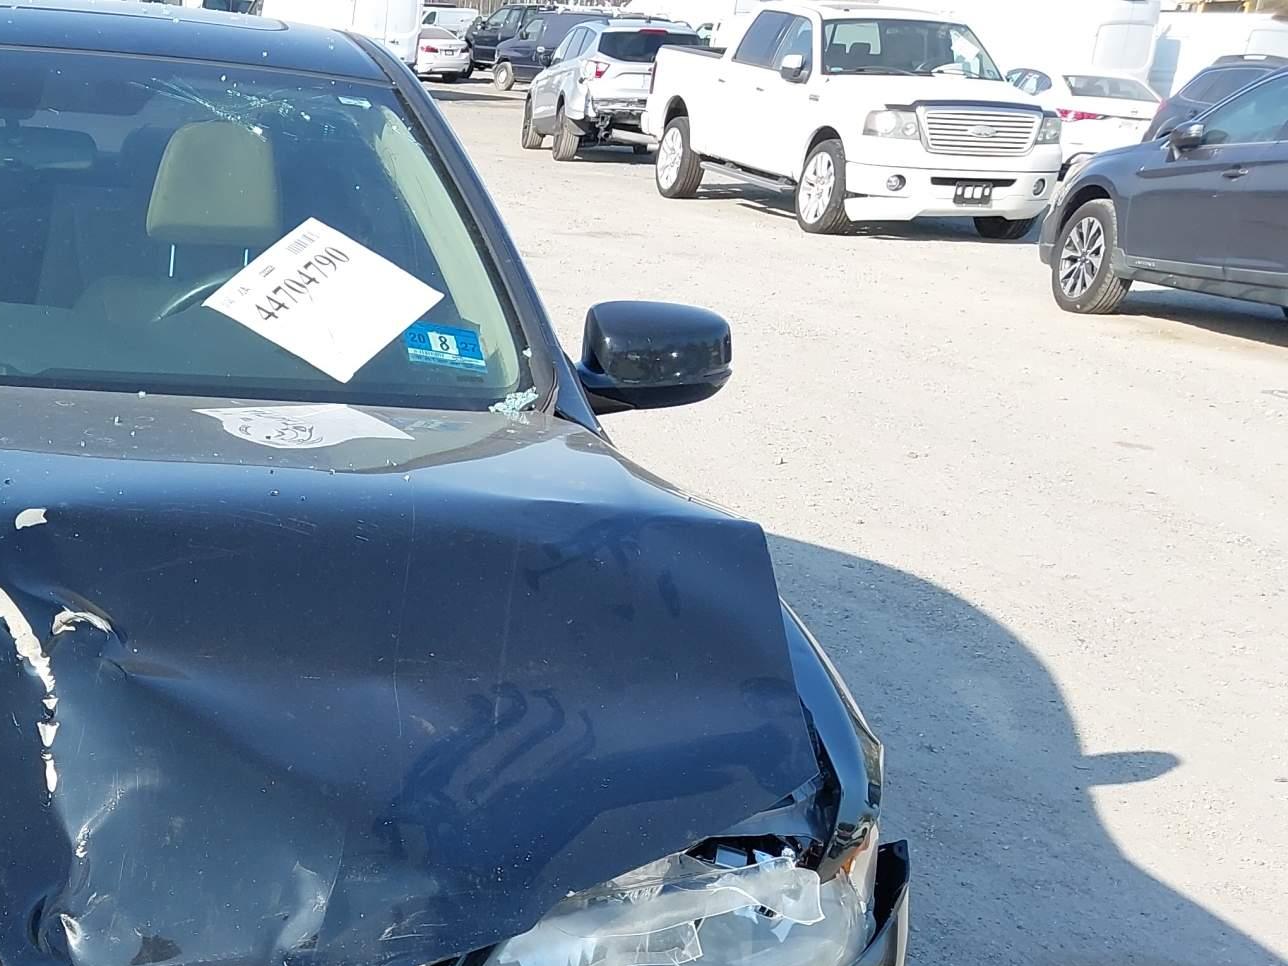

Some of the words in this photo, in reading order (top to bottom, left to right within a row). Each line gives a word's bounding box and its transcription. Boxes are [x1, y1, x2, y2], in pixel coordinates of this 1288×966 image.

[255, 246, 350, 320] 44704790
[408, 331, 426, 344] 20
[438, 335, 450, 351] 8
[459, 341, 477, 353] 27
